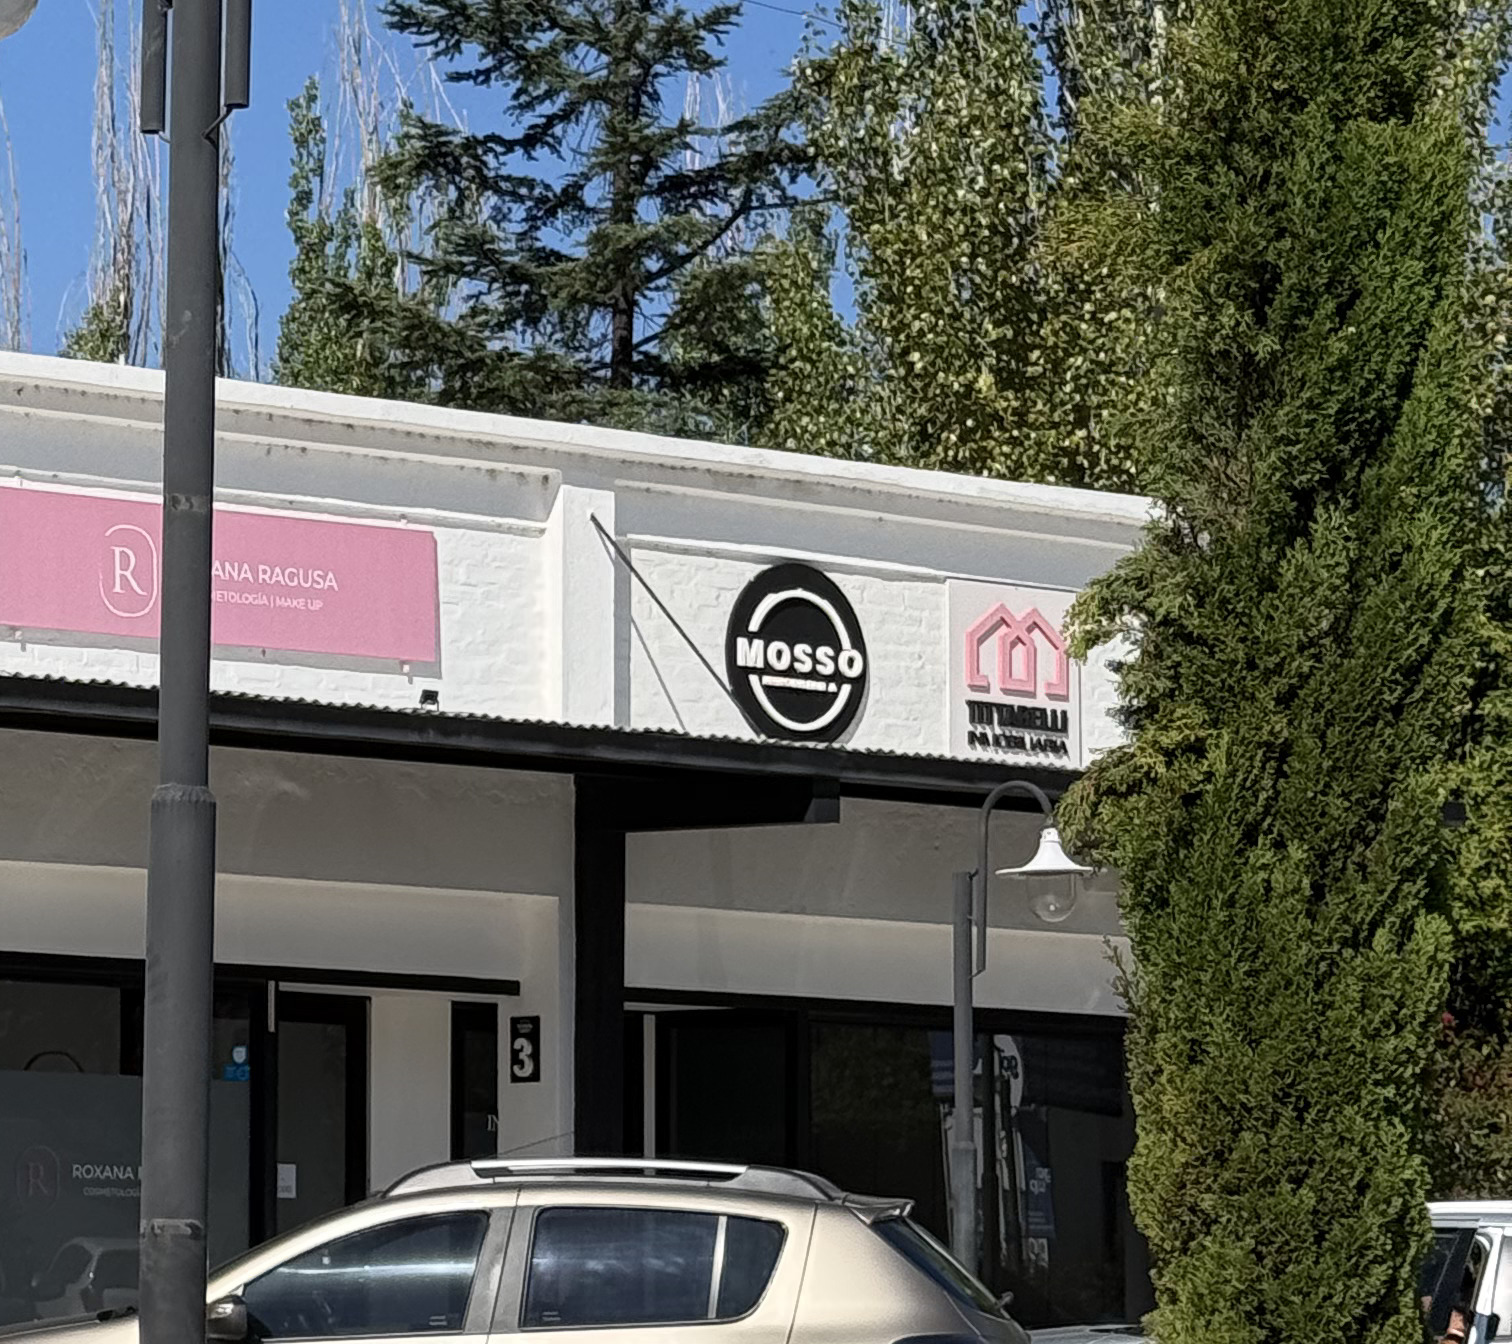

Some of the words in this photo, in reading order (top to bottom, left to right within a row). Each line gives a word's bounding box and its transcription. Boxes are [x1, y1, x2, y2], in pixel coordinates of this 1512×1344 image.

[110, 545, 148, 596] R
[212, 559, 254, 584] ANA
[258, 564, 339, 591] RAGUSA
[212, 590, 269, 607] ETOLOGÍA
[276, 596, 306, 610] MAKE
[307, 599, 324, 611] UP
[736, 636, 863, 678] MOSSO
[512, 1037, 534, 1078] 3
[72, 1164, 134, 1180] ROXANA
